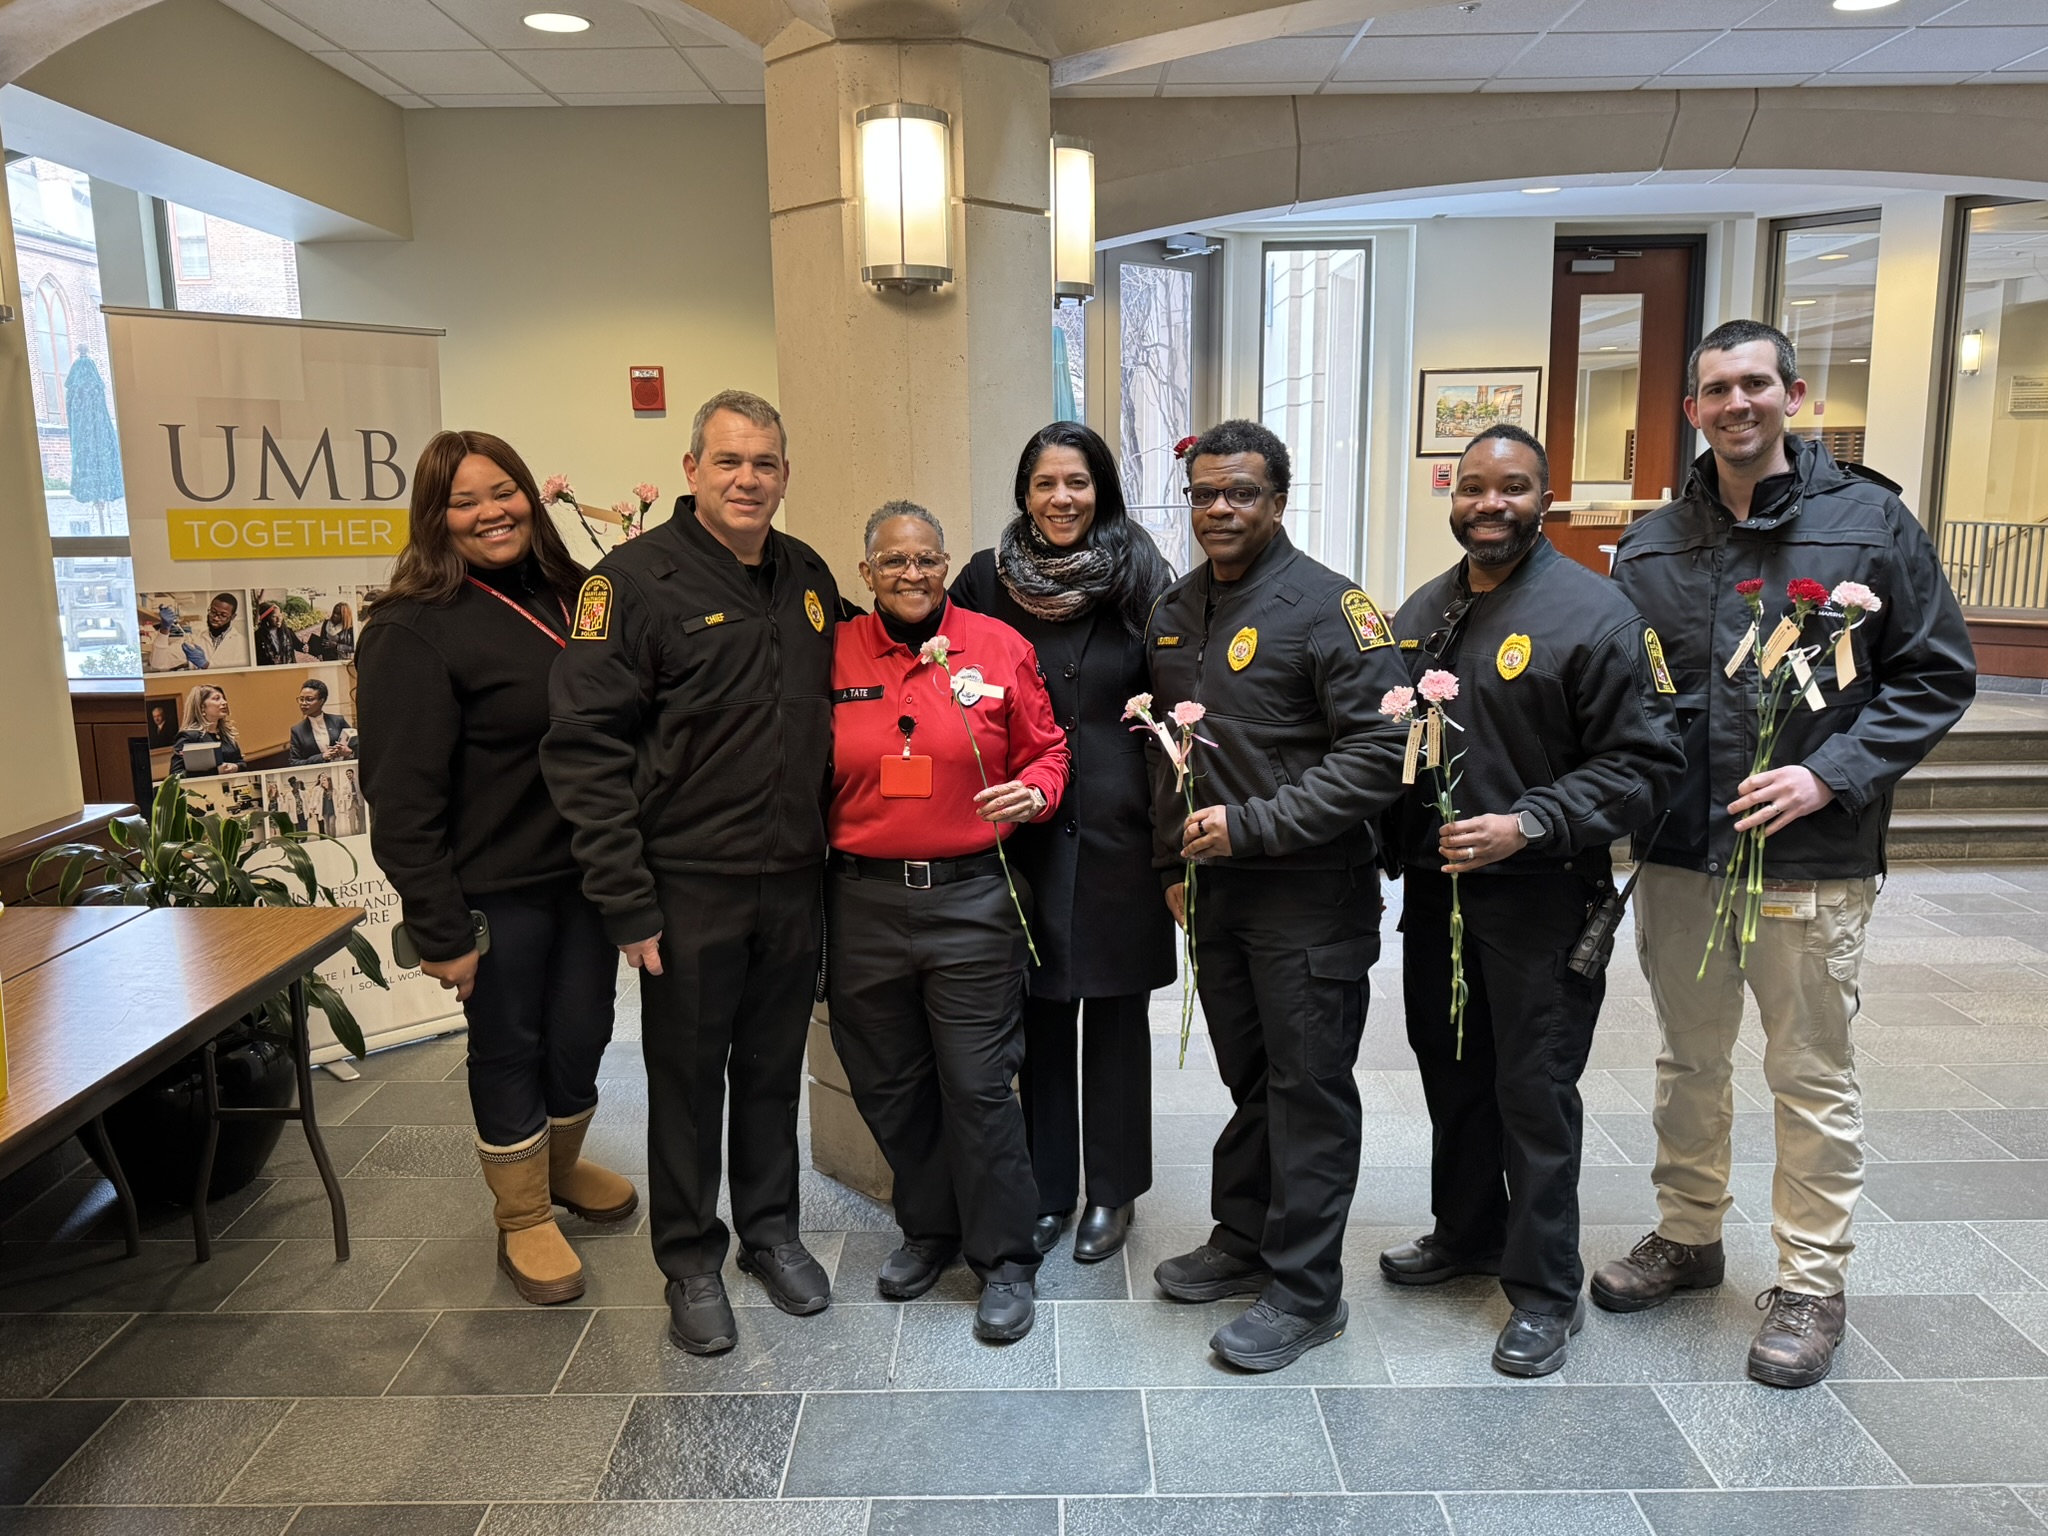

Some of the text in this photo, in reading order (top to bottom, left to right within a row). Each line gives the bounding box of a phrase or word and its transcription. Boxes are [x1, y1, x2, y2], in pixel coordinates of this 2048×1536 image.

[158, 423, 407, 502] UMB
[184, 519, 393, 548] TOGETHER
[704, 612, 725, 625] CHIEF
[1817, 610, 1846, 619] MARSHA
[849, 688, 869, 698] TATE
